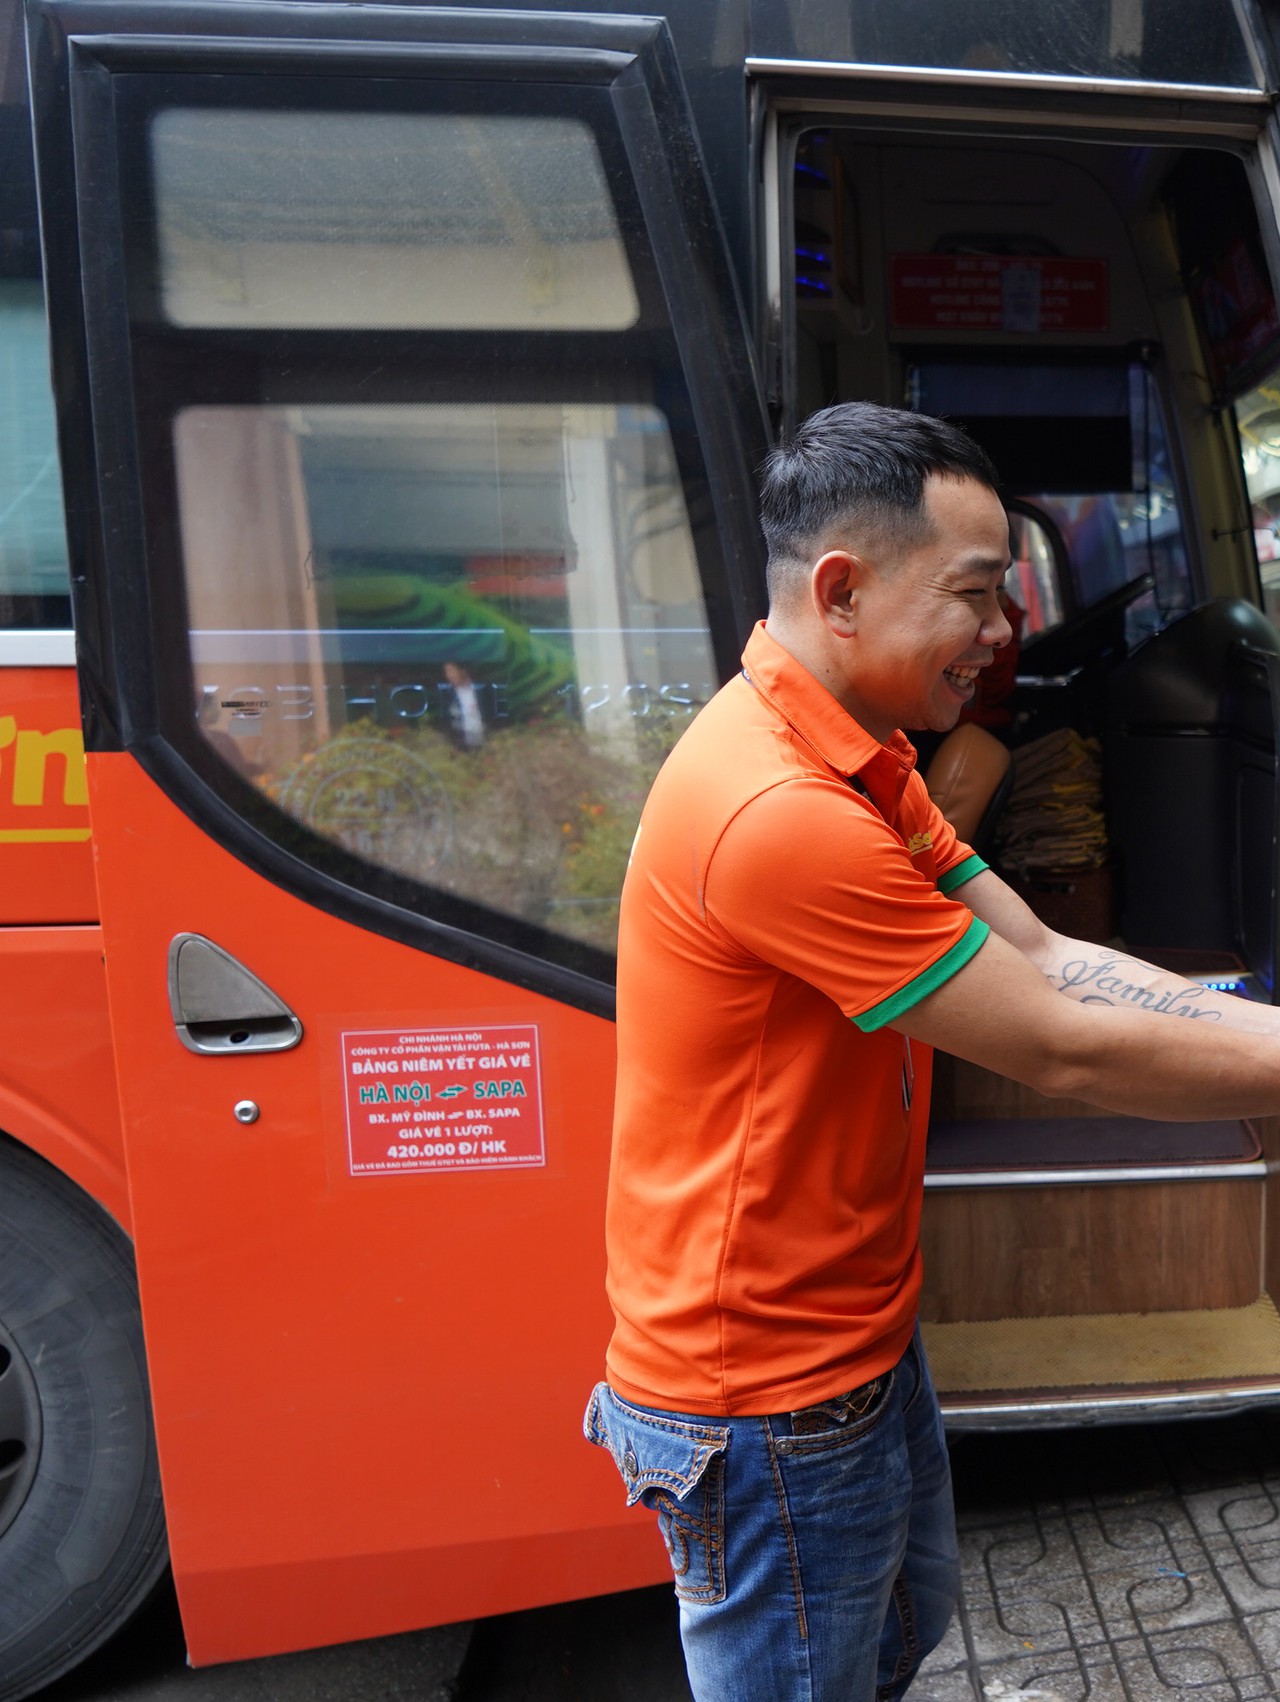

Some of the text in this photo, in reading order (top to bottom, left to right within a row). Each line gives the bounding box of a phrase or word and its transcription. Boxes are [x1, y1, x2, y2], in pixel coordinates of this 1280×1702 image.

[399, 1035, 415, 1044] CHI
[450, 1033, 464, 1042] HÀ
[351, 1047, 378, 1056] CÔNG
[378, 1046, 390, 1055] TY
[467, 1043, 491, 1052] FUTA
[352, 1058, 399, 1075] BẢNG
[402, 1056, 444, 1073] NIÊM
[446, 1054, 476, 1071] YẾT
[478, 1054, 508, 1070] GIÁ
[360, 1079, 527, 1107] HÀ NỘI SAPA
[368, 1113, 390, 1124] BX.
[413, 1109, 446, 1122] ĐÌNH
[466, 1109, 487, 1119] BX.
[488, 1107, 520, 1118] SAPA
[398, 1126, 423, 1139] GIÁ
[424, 1125, 442, 1138] VÉ
[444, 1126, 451, 1138] 1
[387, 1143, 456, 1159] 420.000
[481, 1140, 507, 1154] HK
